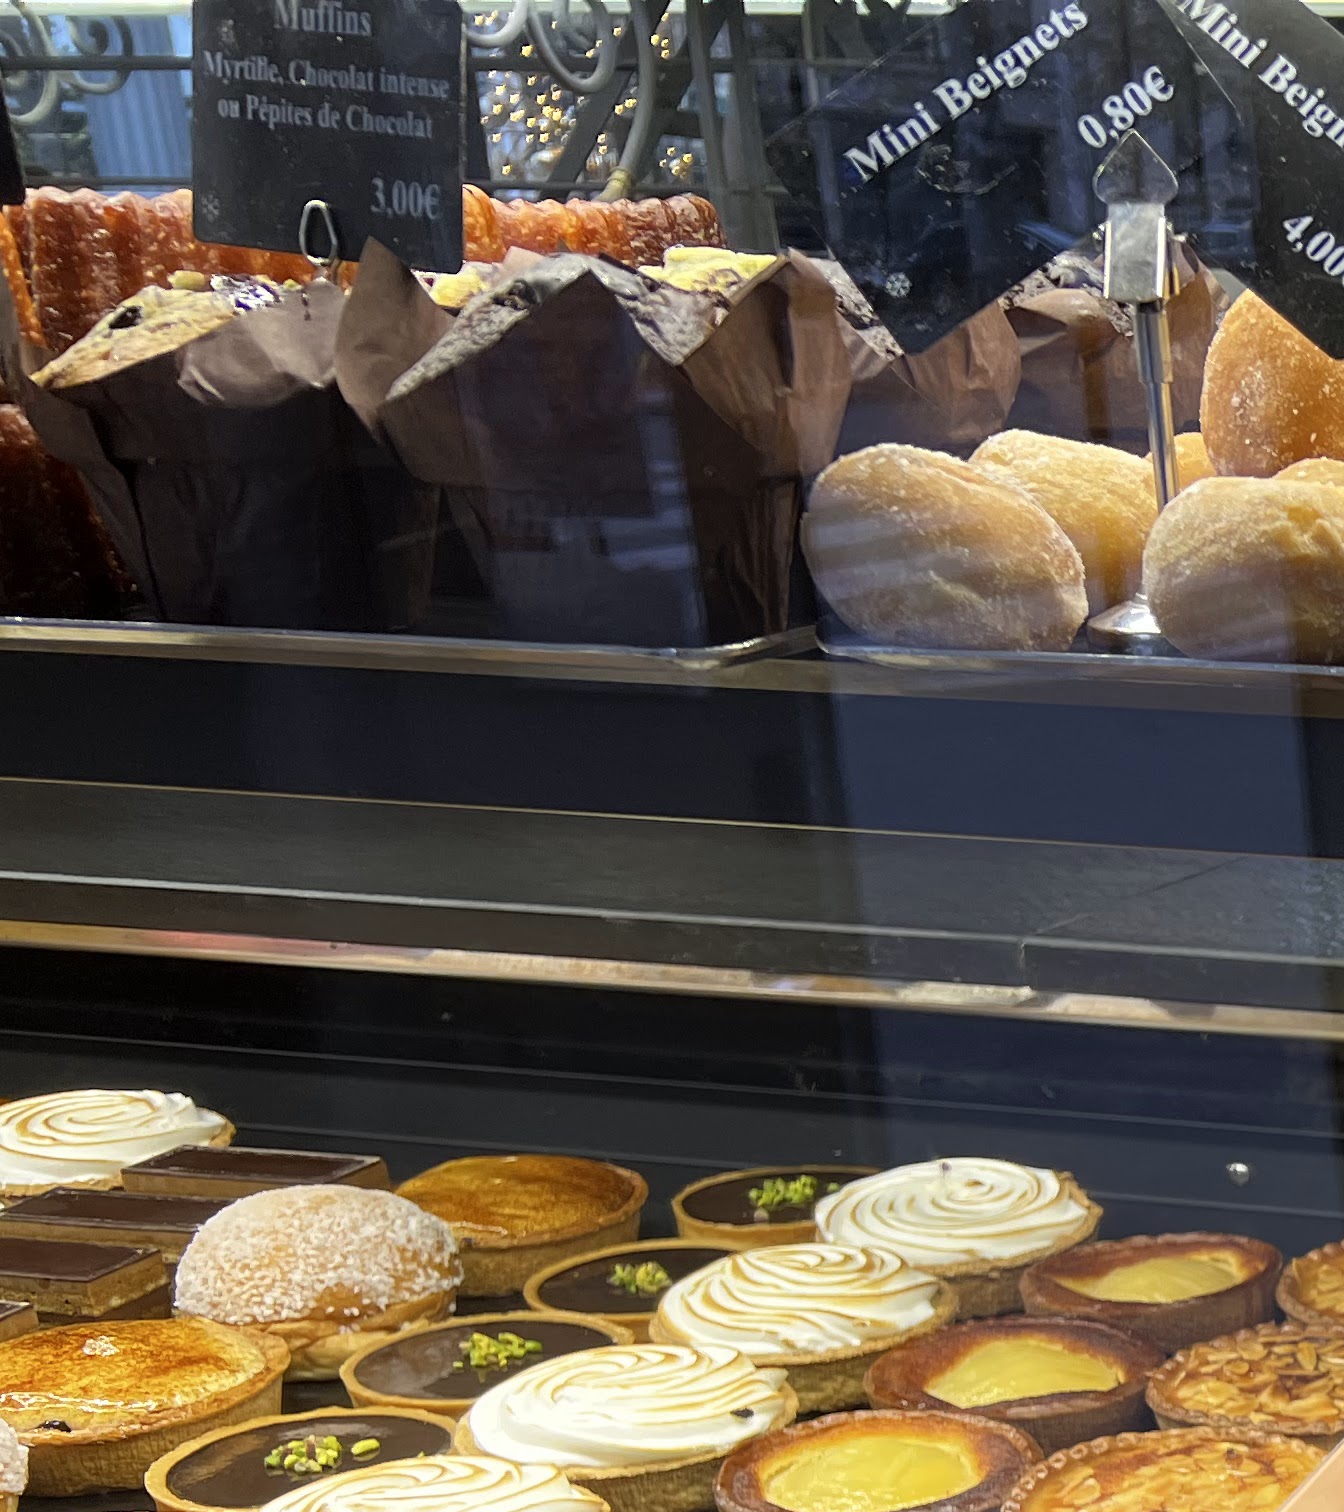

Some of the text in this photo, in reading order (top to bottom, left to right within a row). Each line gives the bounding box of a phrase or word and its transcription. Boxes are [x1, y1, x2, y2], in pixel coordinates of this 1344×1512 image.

[273, 0, 373, 37] Muffins
[1176, 0, 1269, 69] Mini
[203, 50, 450, 98] Myrtille, Chocolat intense
[843, 2, 1089, 182] Mini Beignets
[217, 94, 434, 138] ou Pépites de Chocolat
[1077, 65, 1175, 149] 0,80€
[370, 176, 441, 220] 3,00€
